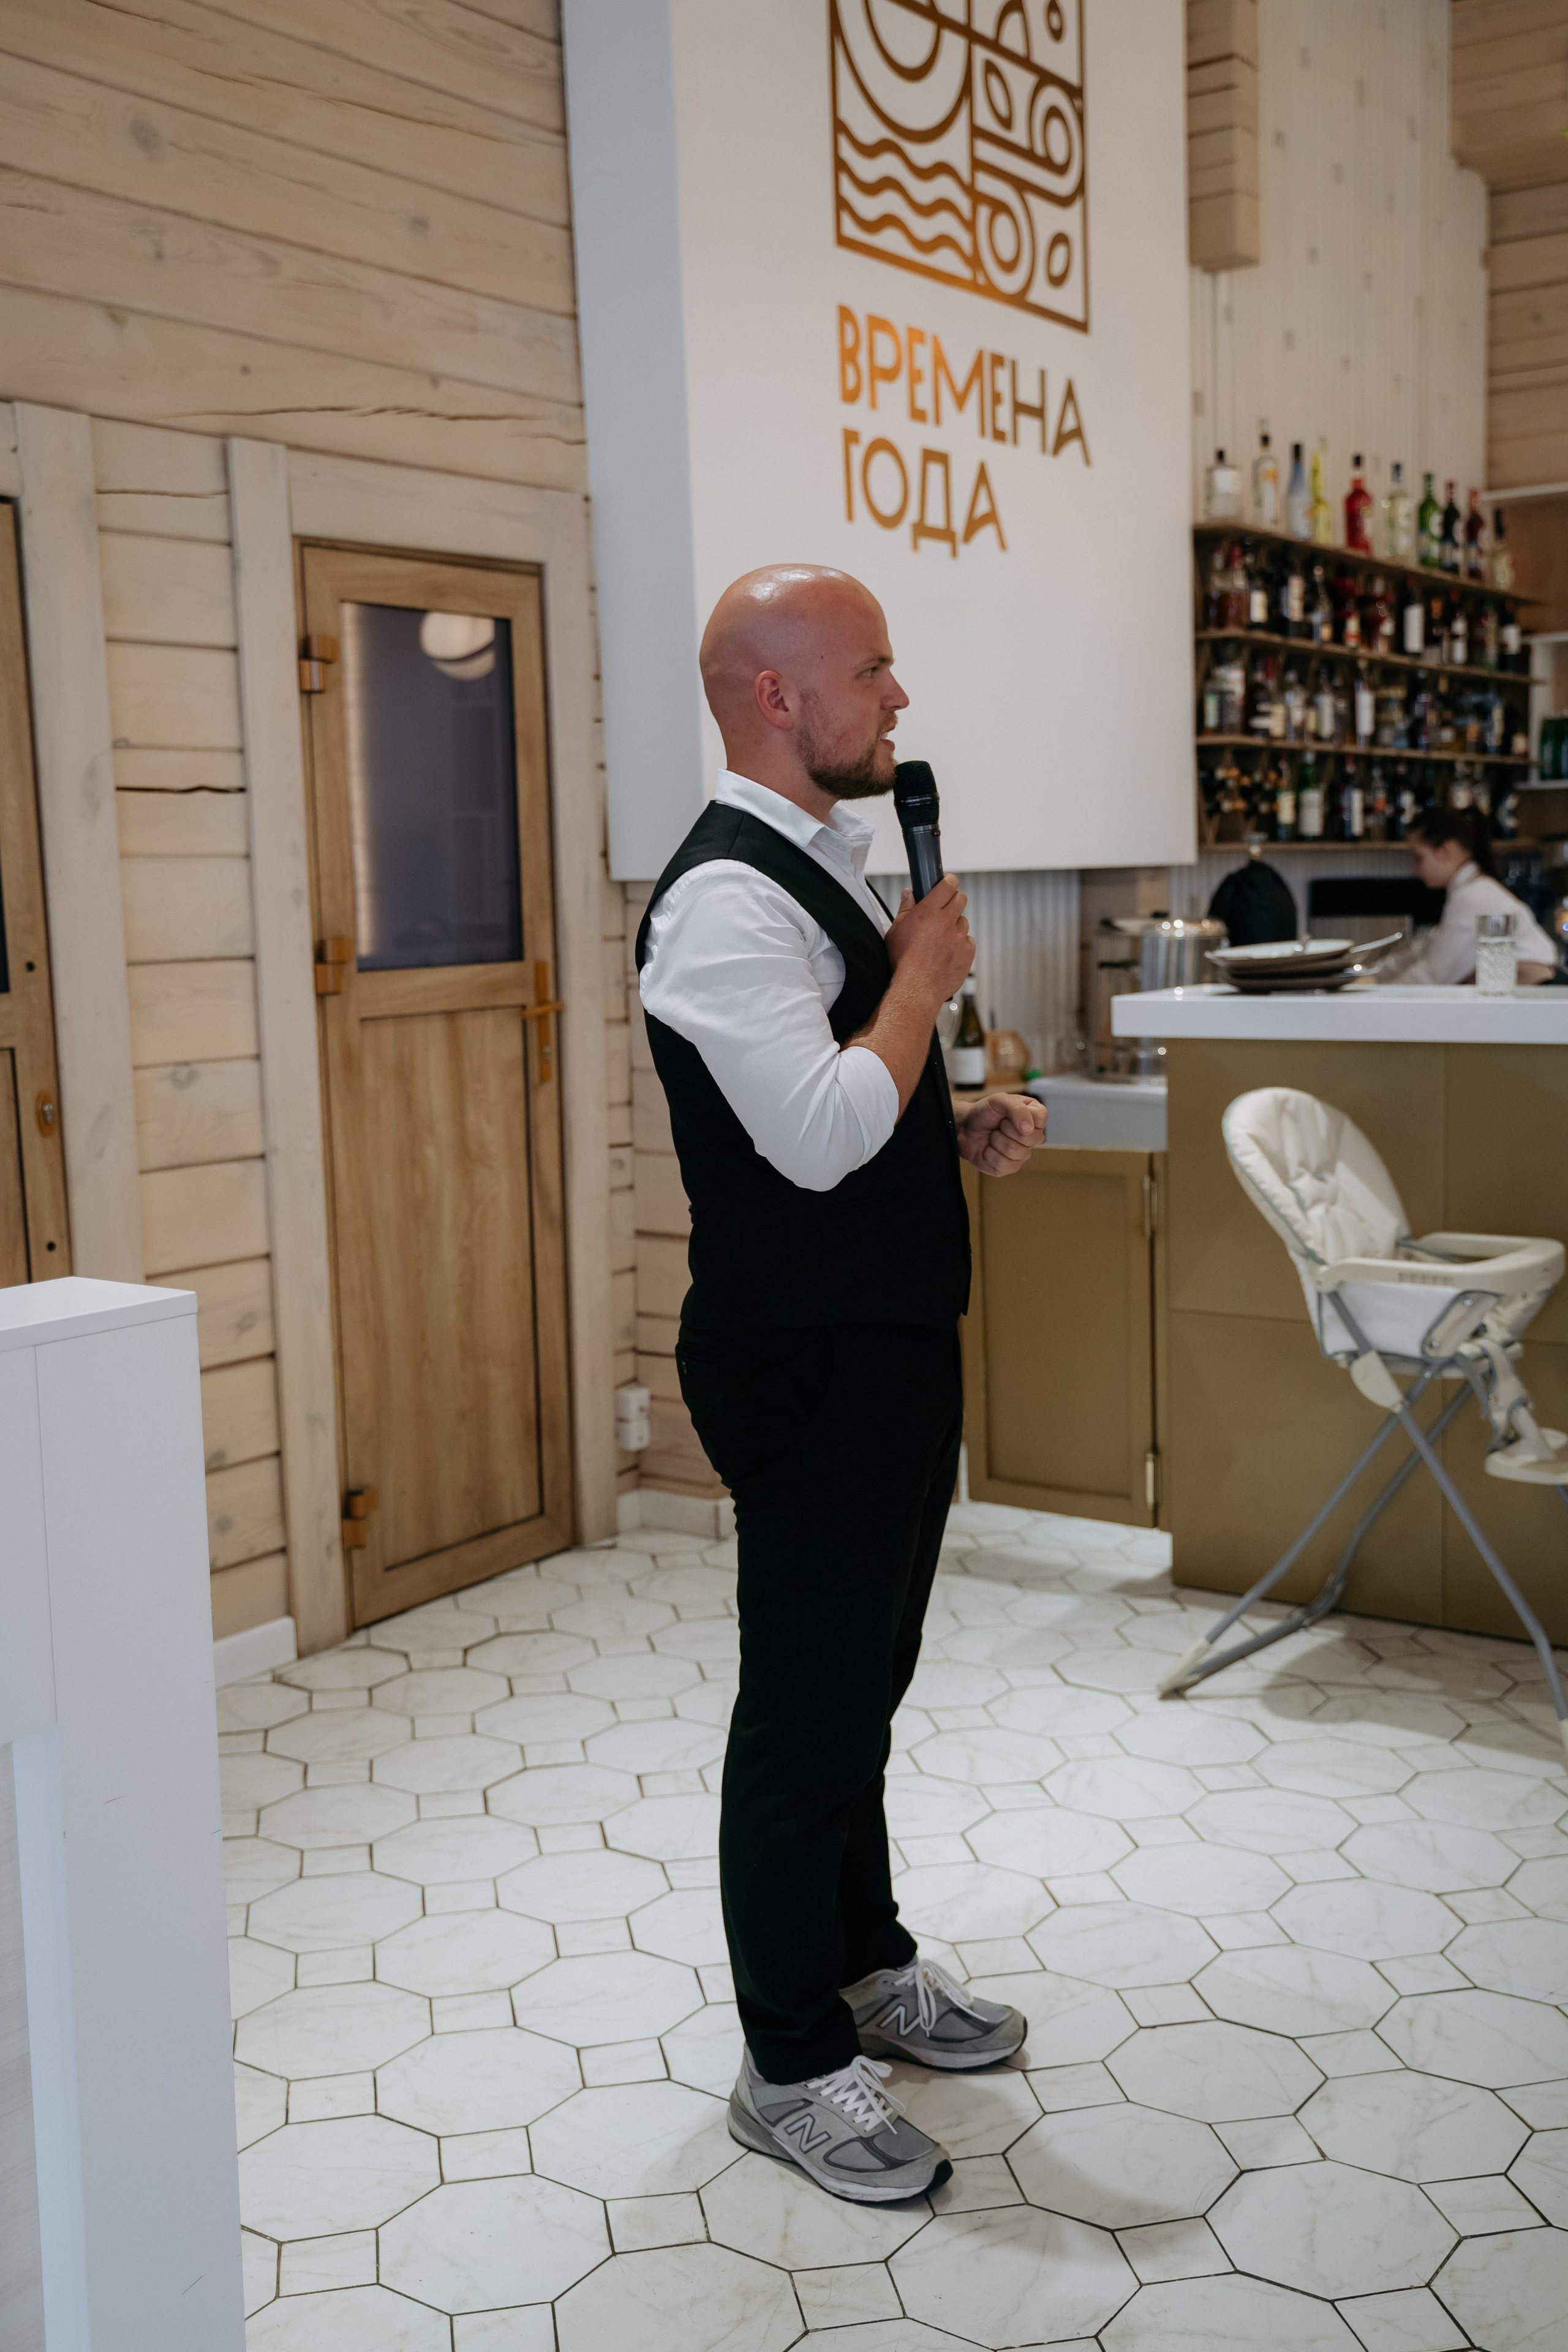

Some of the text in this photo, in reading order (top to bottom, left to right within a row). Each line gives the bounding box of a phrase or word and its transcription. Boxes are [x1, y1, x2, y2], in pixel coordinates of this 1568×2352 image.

[838, 304, 1091, 467] ВРЕМЕНА
[842, 427, 1008, 559] ГОДА
[876, 2003, 921, 2037] N
[784, 2113, 832, 2154] N
